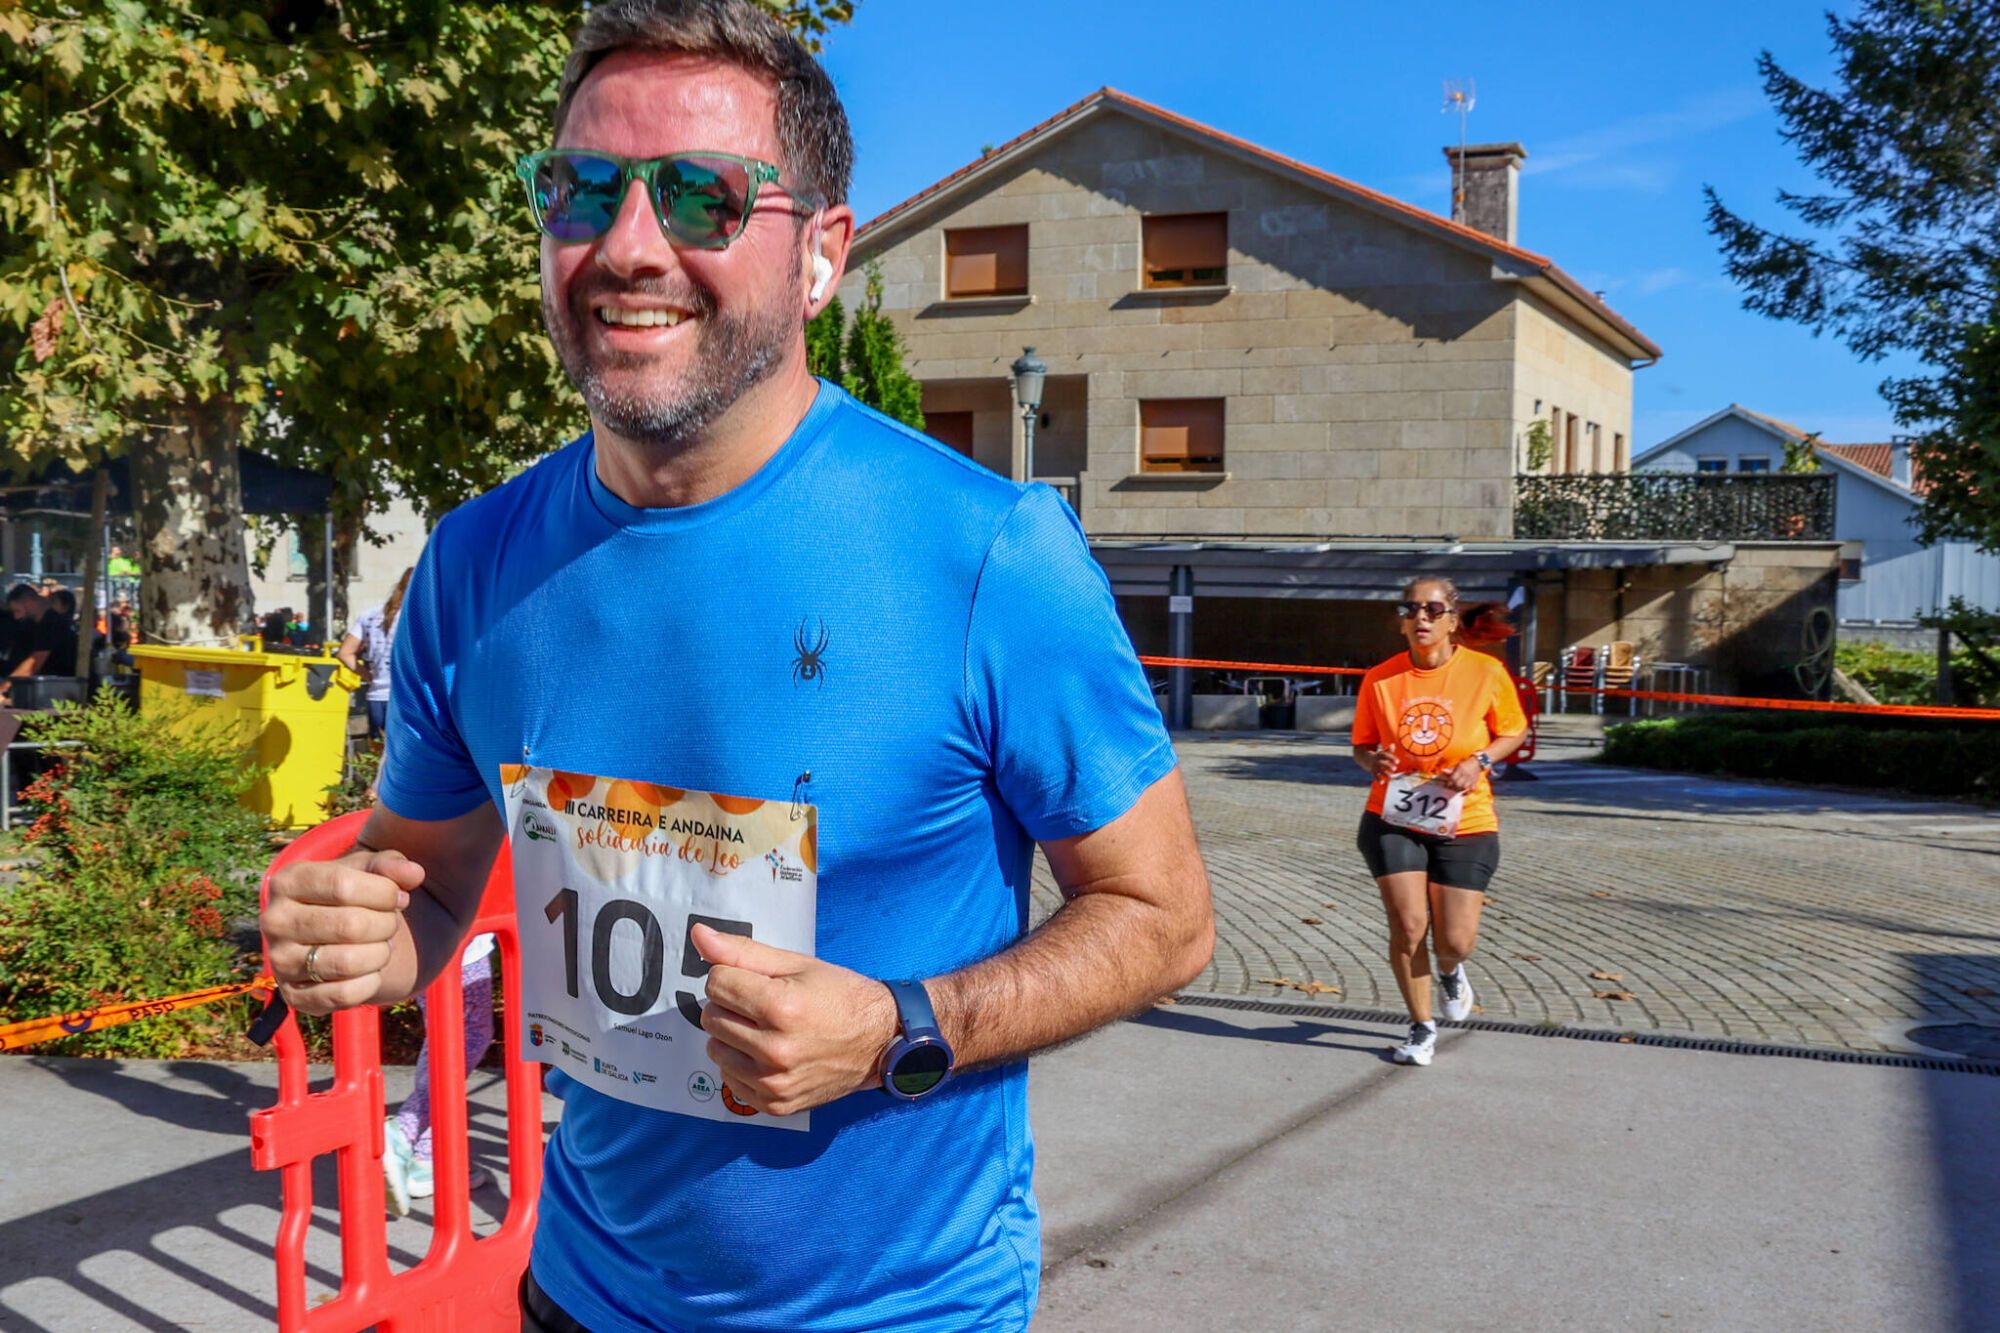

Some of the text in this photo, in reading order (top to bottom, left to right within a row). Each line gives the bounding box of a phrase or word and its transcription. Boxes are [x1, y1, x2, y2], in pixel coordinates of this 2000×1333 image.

[564, 800, 745, 844] III CARREIRA E ANDAINA
[1394, 789, 1449, 820] 312
[577, 819, 745, 876] solidaria de Leo
[544, 888, 753, 1031] 105
[613, 1022, 637, 1034] Samuel
